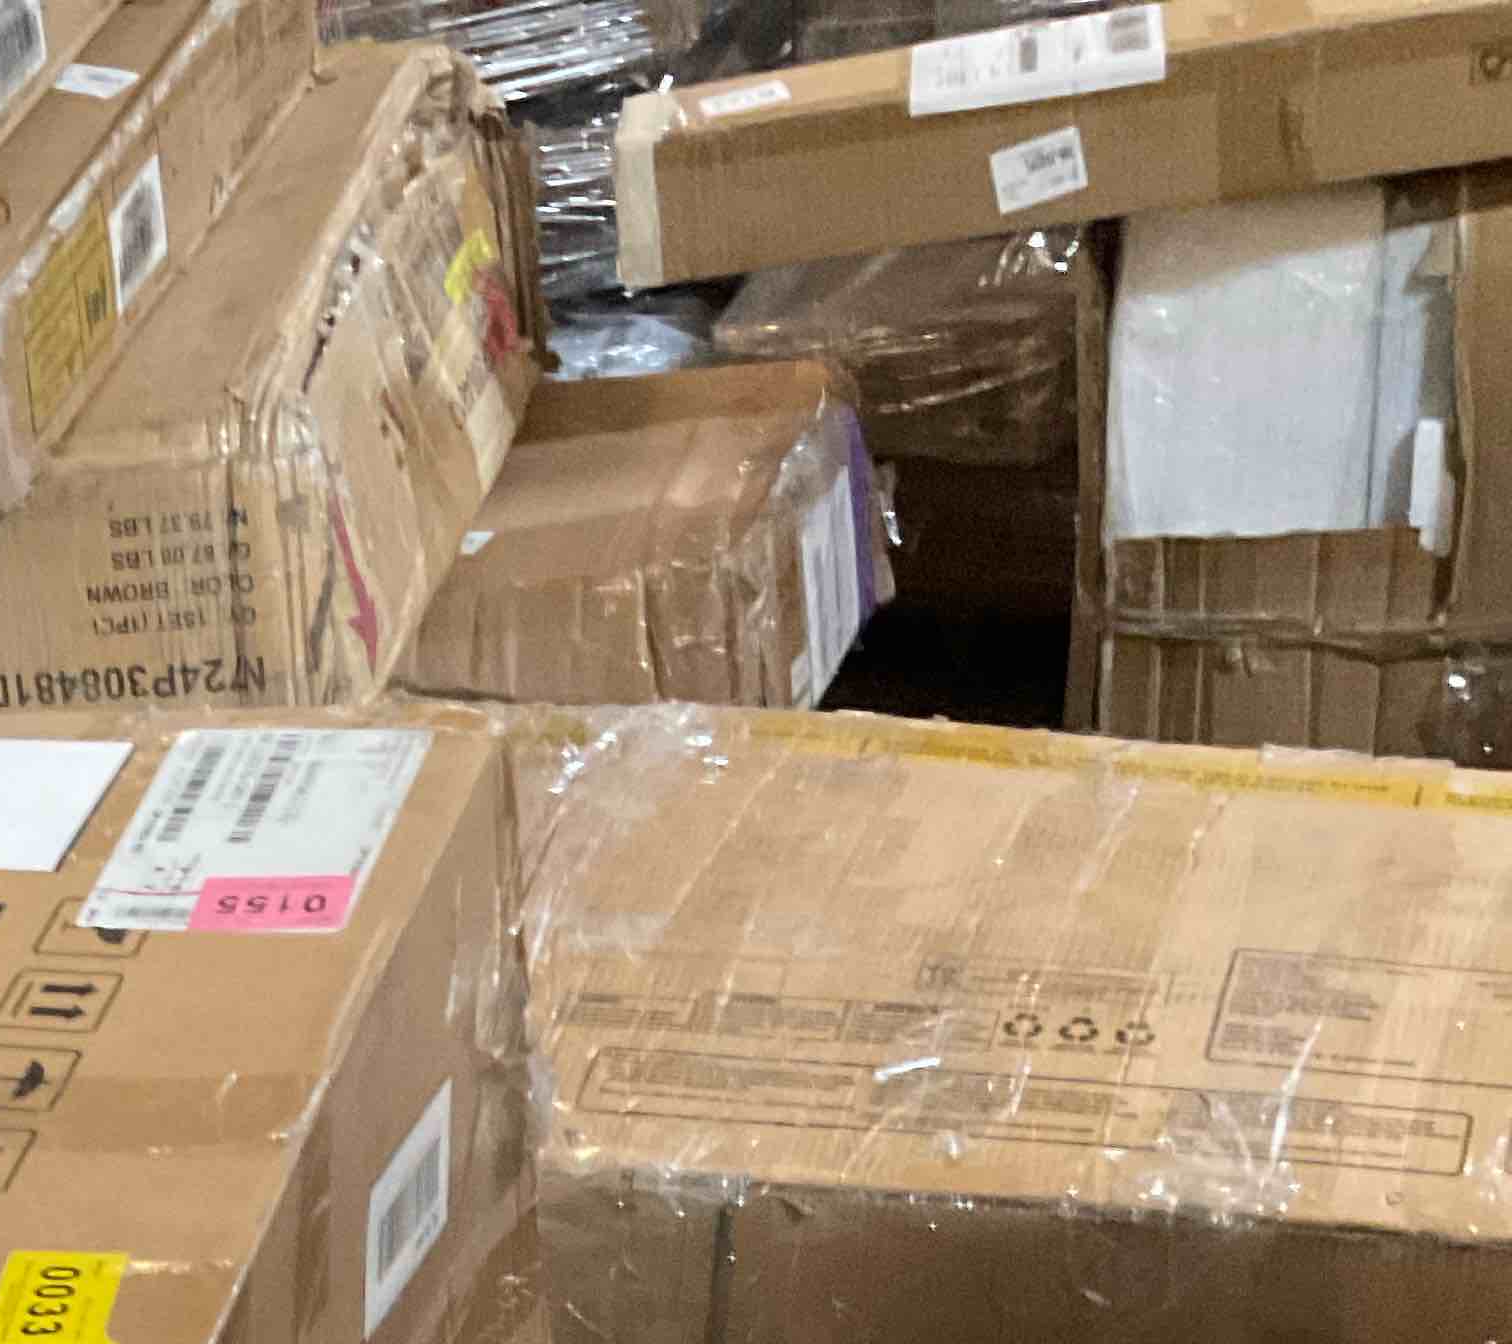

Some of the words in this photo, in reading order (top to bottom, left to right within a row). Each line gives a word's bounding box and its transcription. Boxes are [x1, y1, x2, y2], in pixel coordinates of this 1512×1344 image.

[109, 514, 152, 539] LBS
[110, 547, 155, 571] LBS
[86, 579, 170, 604] BROWN
[215, 891, 328, 915] 0155
[20, 1265, 83, 1337] 0033
